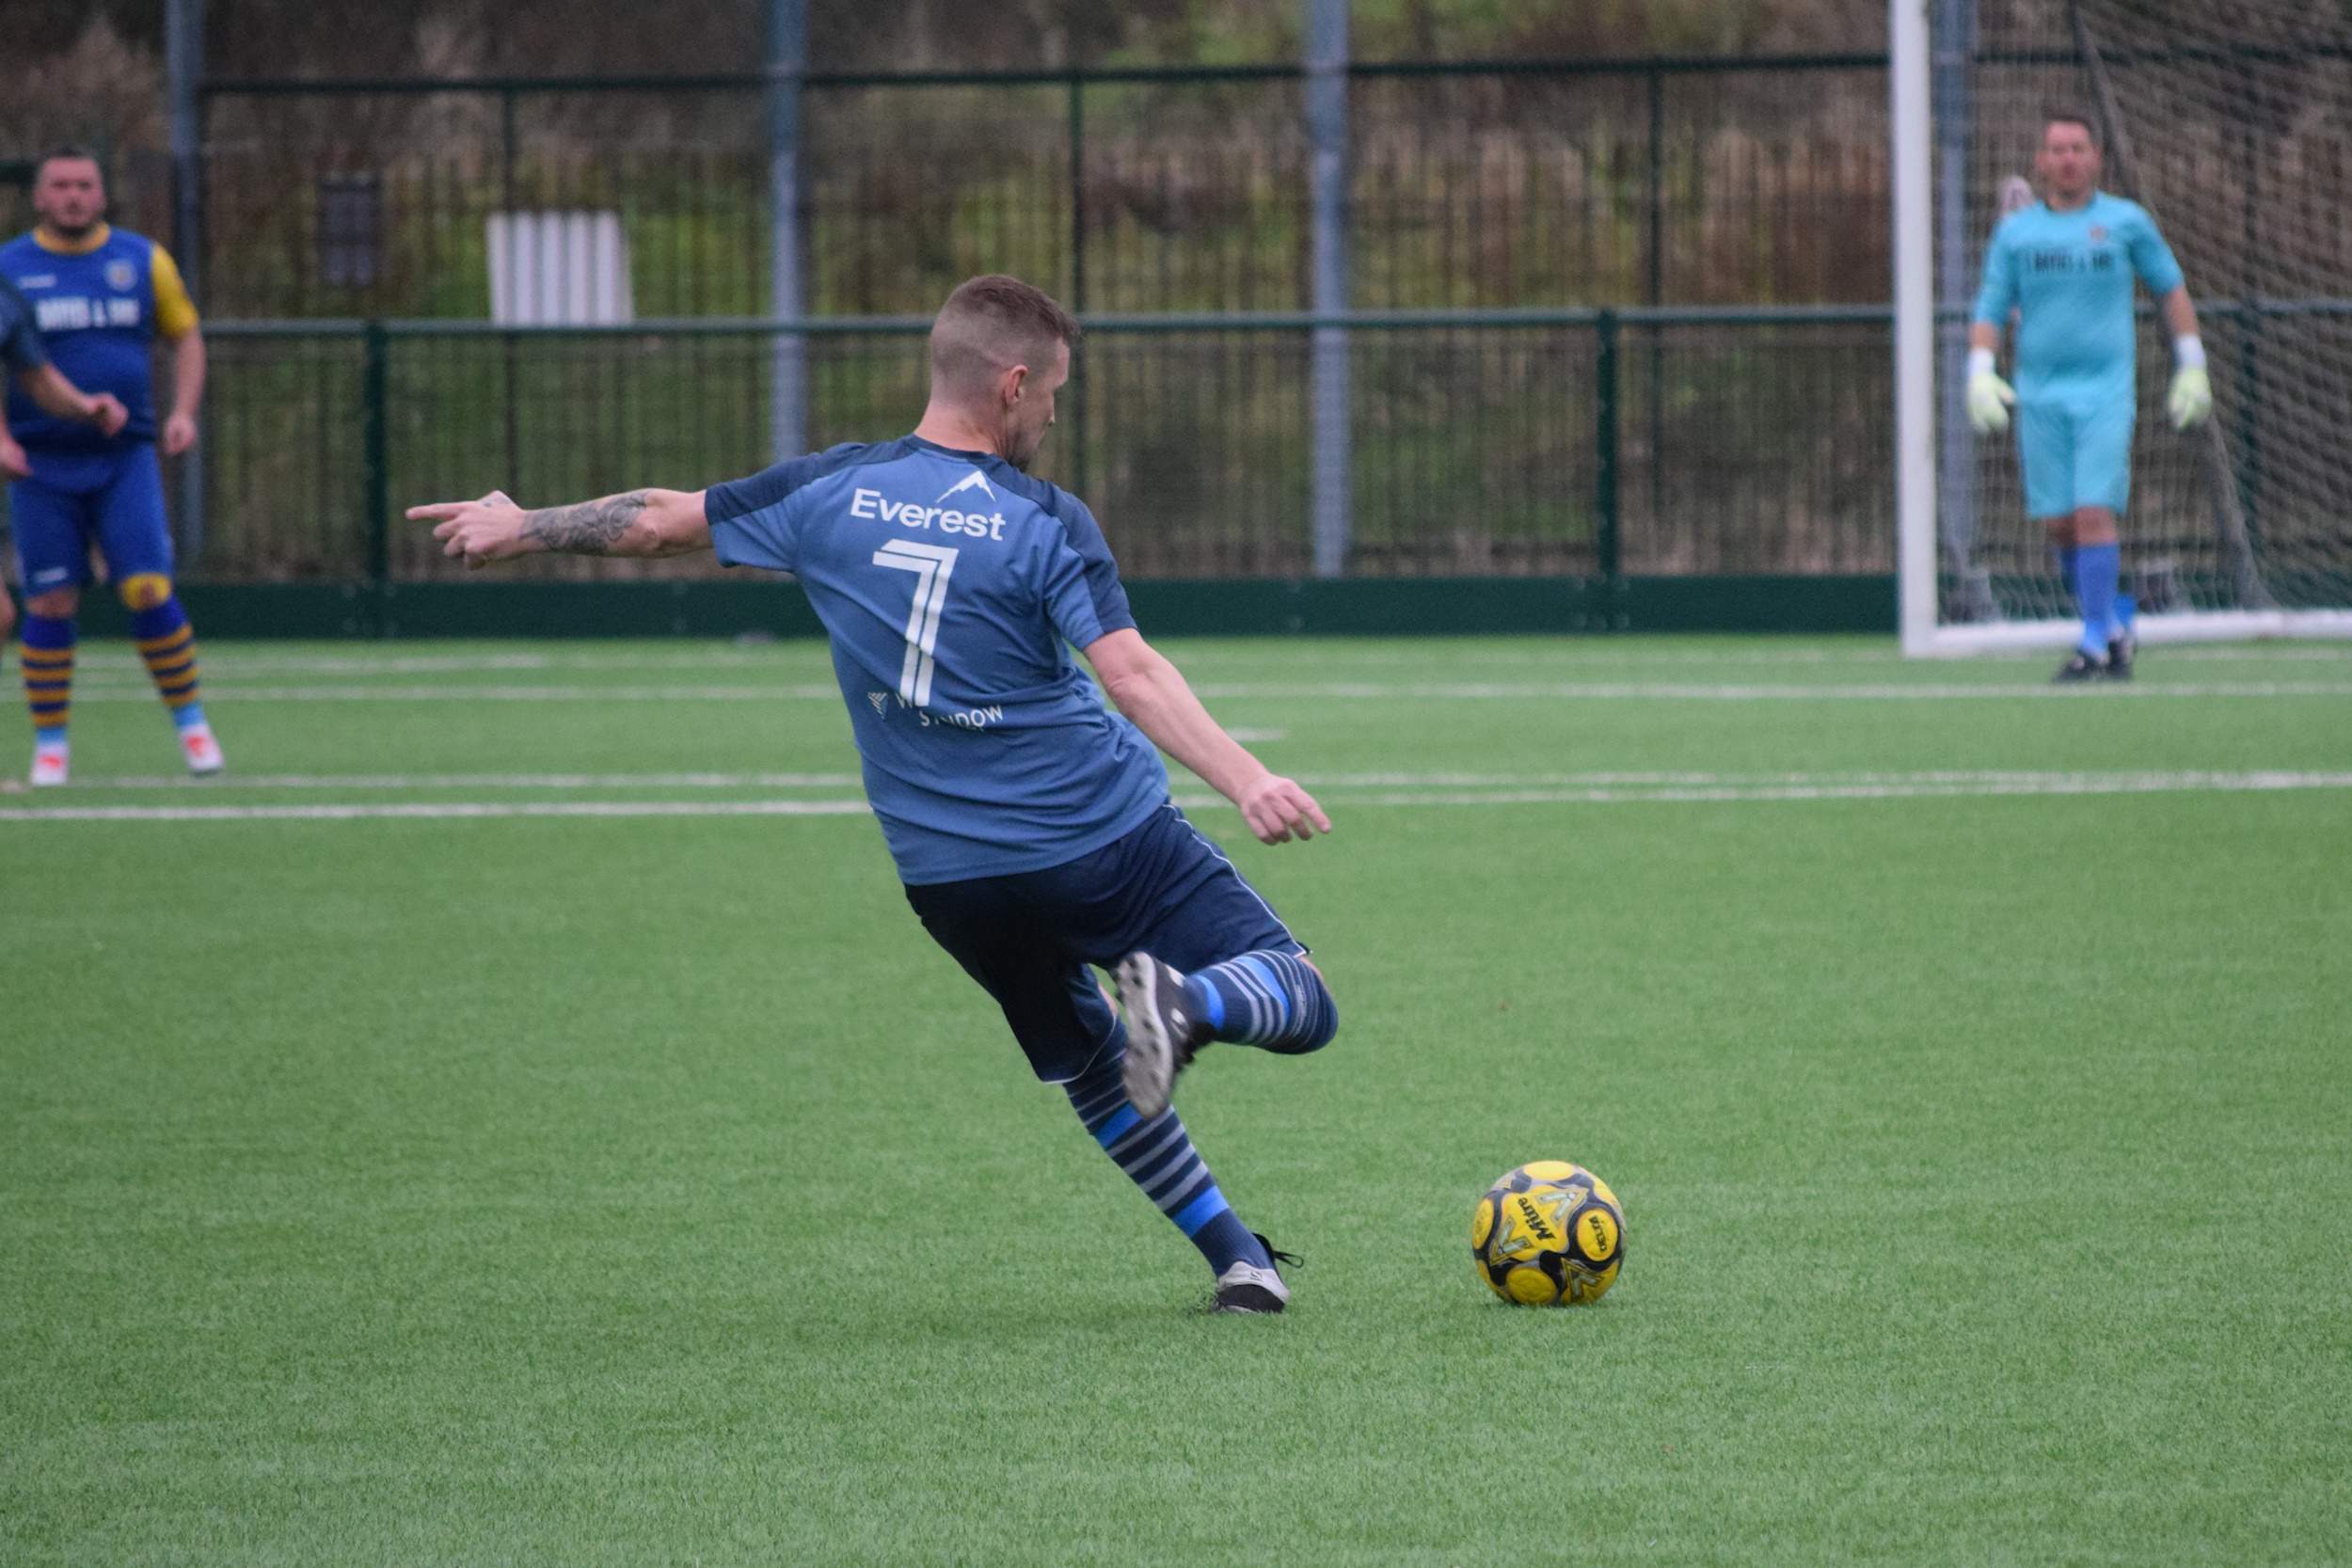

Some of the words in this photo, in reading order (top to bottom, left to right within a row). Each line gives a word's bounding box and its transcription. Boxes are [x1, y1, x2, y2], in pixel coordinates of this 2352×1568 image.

[850, 487, 1007, 542] Everest
[872, 538, 960, 707] 7
[1517, 1196, 1556, 1242] Mitre
